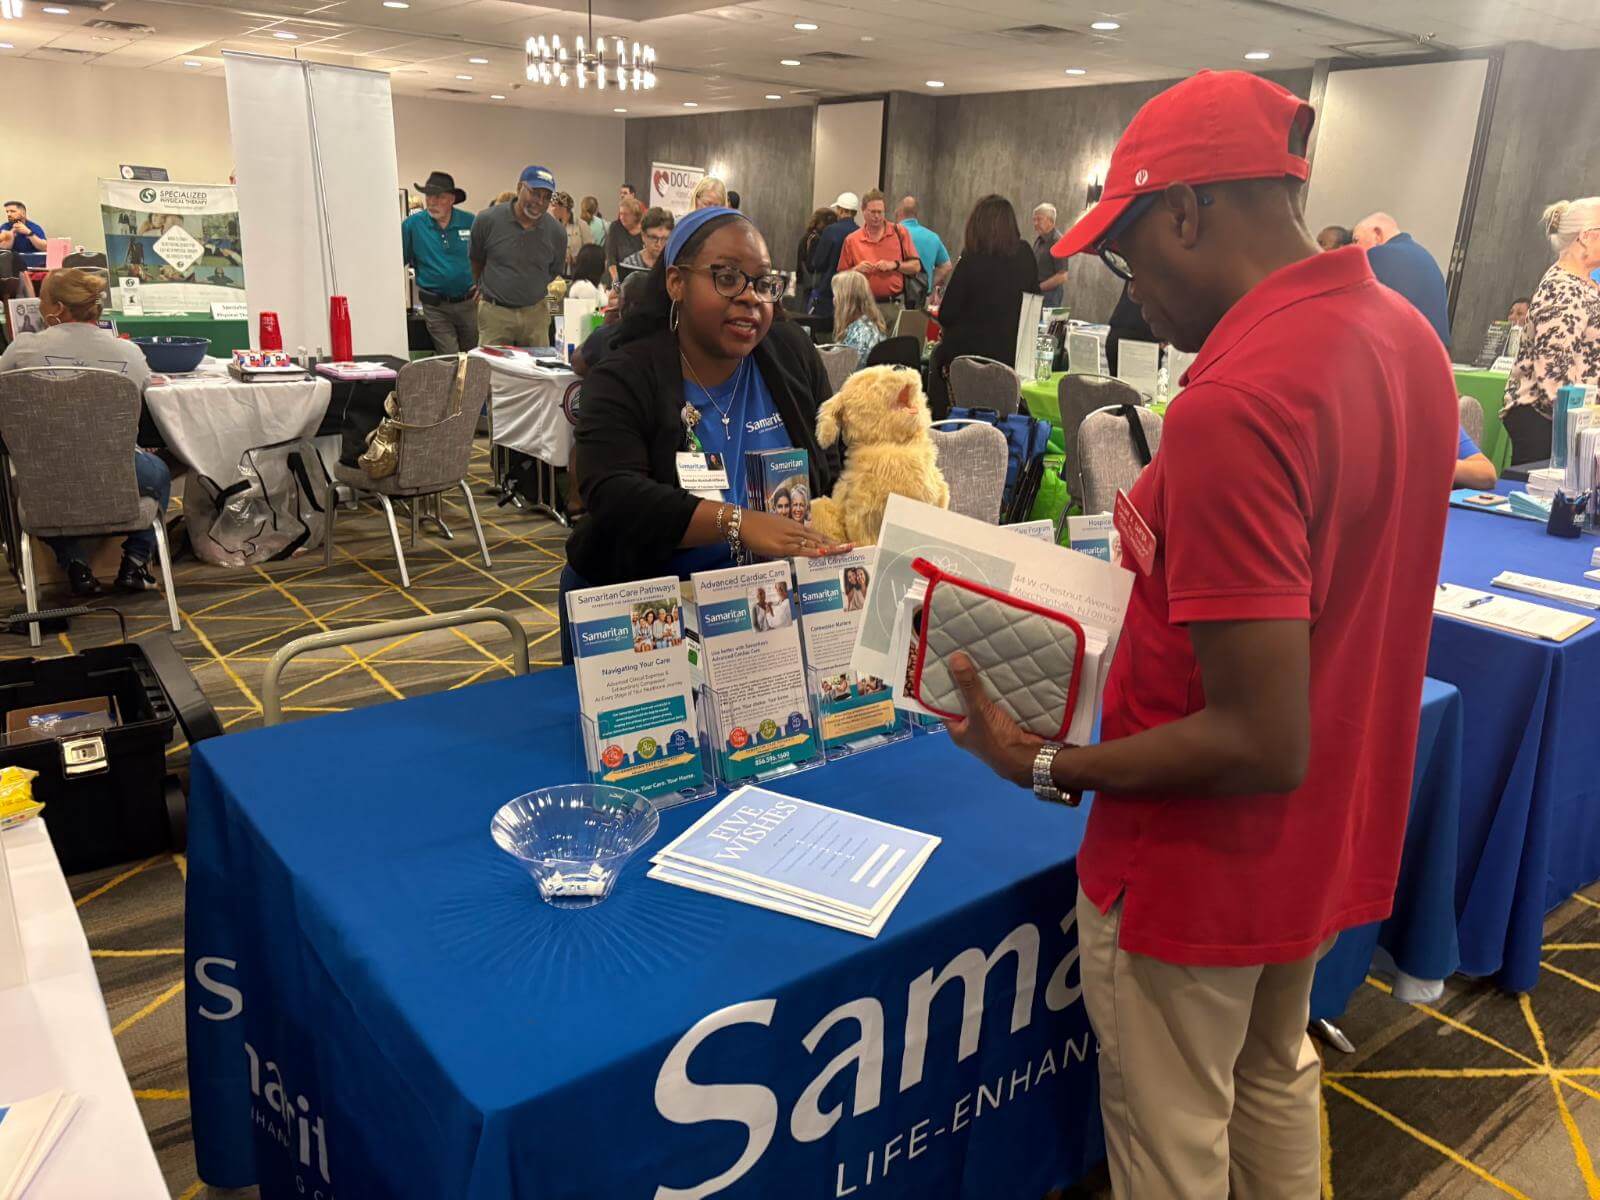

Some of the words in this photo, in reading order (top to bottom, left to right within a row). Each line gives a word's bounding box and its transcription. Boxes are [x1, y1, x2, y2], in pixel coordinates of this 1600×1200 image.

[160, 190, 207, 199] SPECIALIZED
[770, 459, 804, 471] Samaritan
[807, 559, 827, 569] Social
[700, 577, 739, 590] Advanced
[740, 572, 768, 583] Cardiac
[768, 569, 785, 577] Care
[578, 590, 619, 604] Samaritan
[619, 589, 639, 599] Care
[639, 583, 676, 596] Pathways
[802, 588, 839, 602] Samaritan
[1038, 582, 1082, 601] Chestnut
[704, 608, 747, 624] Samaritan
[581, 626, 629, 642] Samaritan
[602, 662, 639, 676] Navigating
[640, 660, 654, 669] Your
[655, 658, 671, 666] Care
[706, 804, 764, 843] FIVE
[714, 800, 799, 861] WISHES
[837, 1032, 1101, 1198] LIFE-ENHAN
